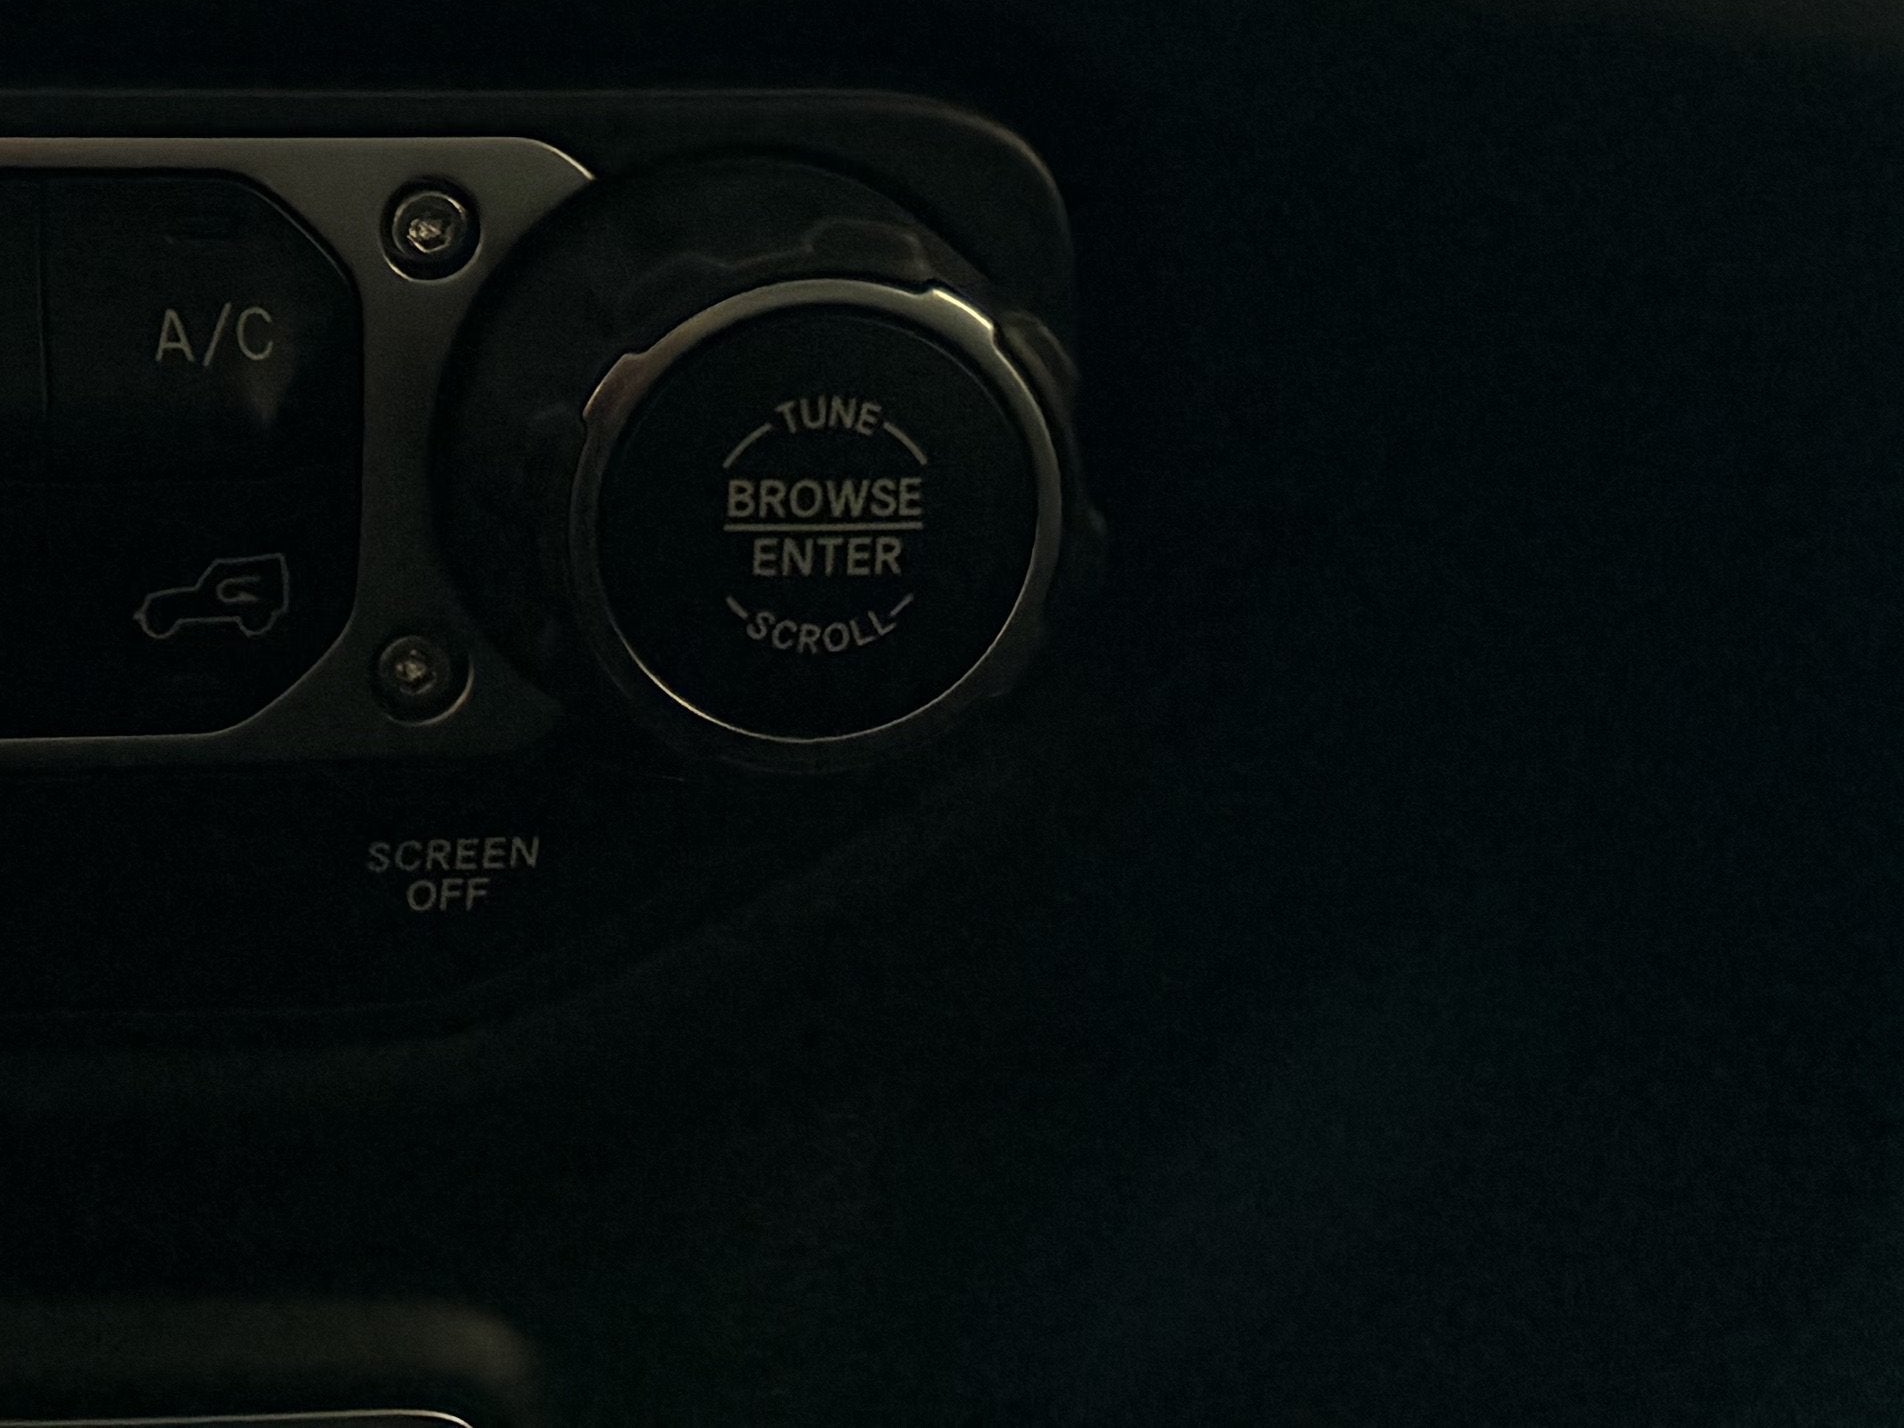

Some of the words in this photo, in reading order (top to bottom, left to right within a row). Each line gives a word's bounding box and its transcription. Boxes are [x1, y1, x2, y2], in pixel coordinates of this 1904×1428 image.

[154, 305, 276, 368] A/C
[775, 395, 882, 437] TUNE
[725, 476, 924, 520] BROWSE
[750, 537, 904, 578] ENTER
[744, 607, 898, 655] SCROLL
[367, 835, 540, 874] SCREEN
[404, 876, 491, 912] OFF
